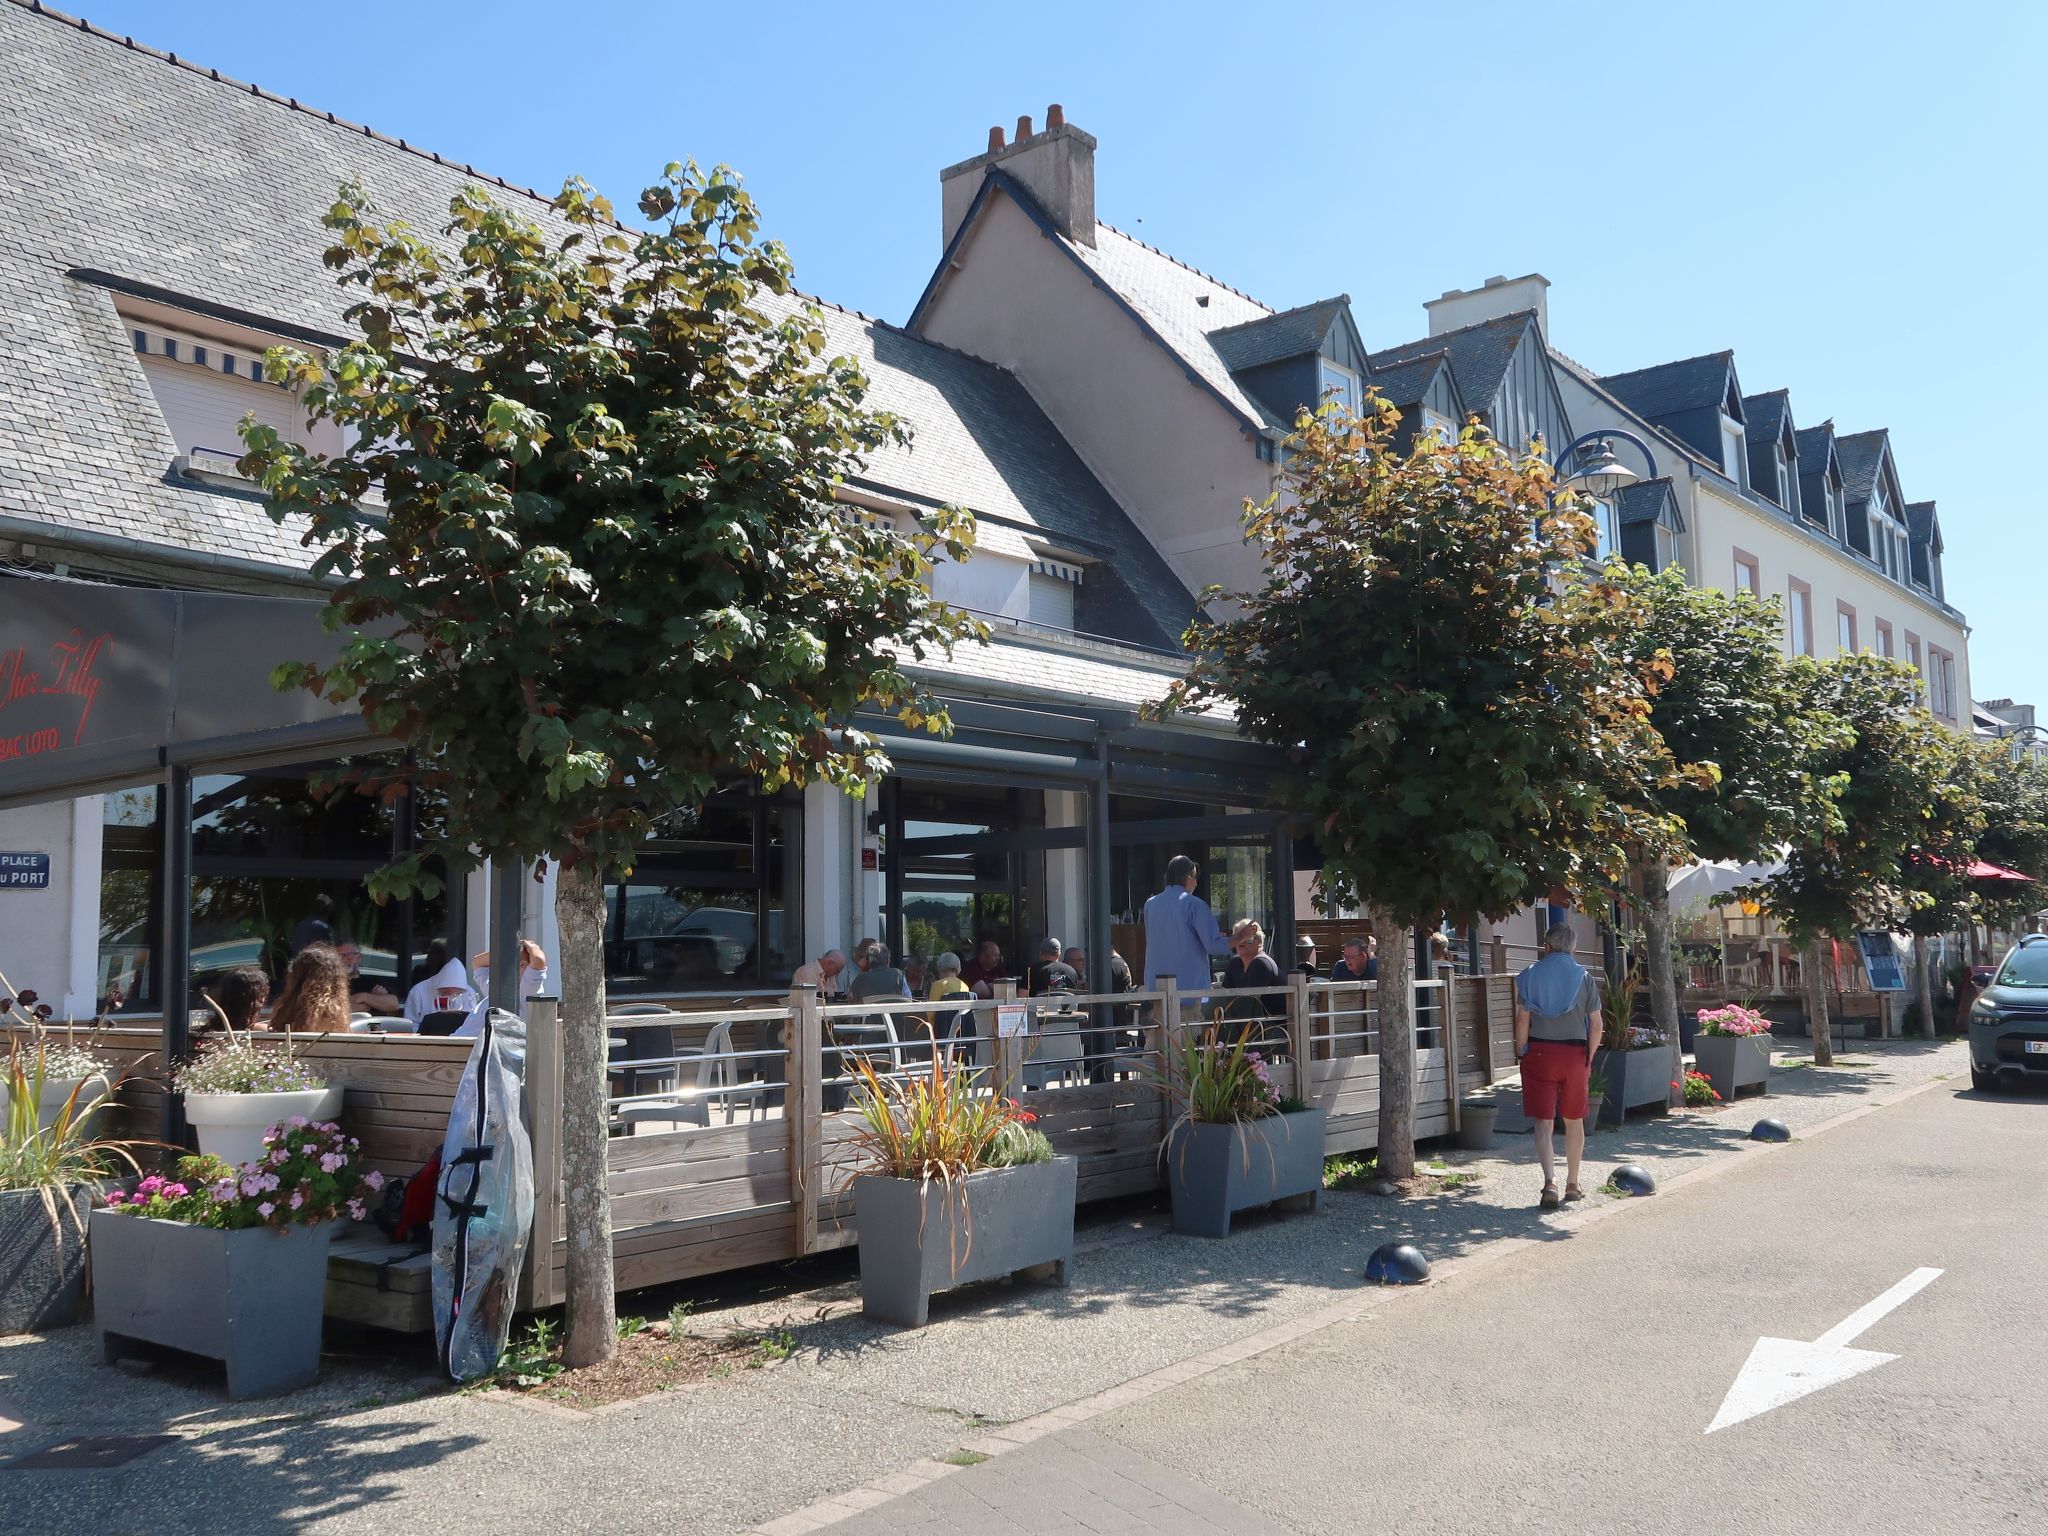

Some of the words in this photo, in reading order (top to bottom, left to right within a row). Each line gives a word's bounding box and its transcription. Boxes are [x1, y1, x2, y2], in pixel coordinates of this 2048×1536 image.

[26, 727, 60, 756] LOTO
[1, 856, 38, 867] PLACE
[11, 872, 46, 884] PORT
